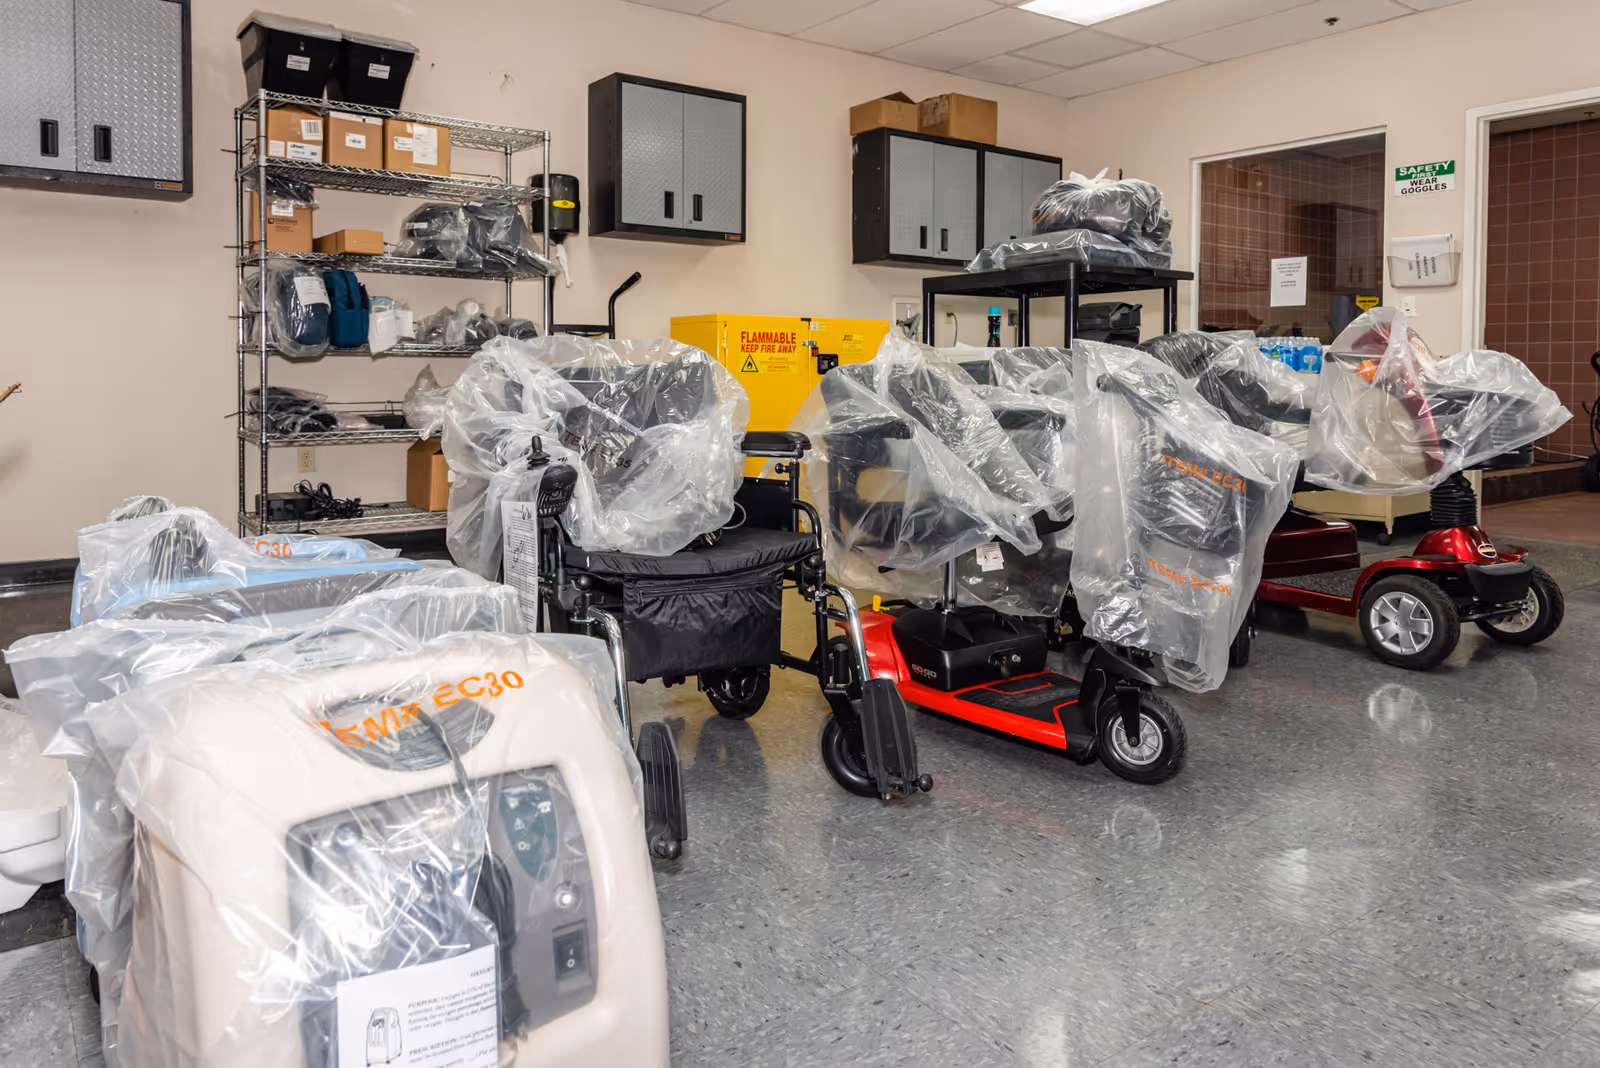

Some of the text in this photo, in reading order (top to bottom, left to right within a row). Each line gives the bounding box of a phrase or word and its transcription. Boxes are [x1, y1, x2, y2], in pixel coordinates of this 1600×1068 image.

[1399, 160, 1451, 176] SAFETY
[1411, 171, 1437, 179] FIRST
[1410, 177, 1438, 187] WEAR
[1401, 183, 1447, 195] GOGGLES
[741, 331, 796, 344] FLAMMABLE
[741, 344, 796, 354] KEEP FIRE AWAY
[1161, 454, 1208, 480] ITEM#
[1146, 556, 1187, 586] ITEM#
[432, 670, 524, 708] EC30
